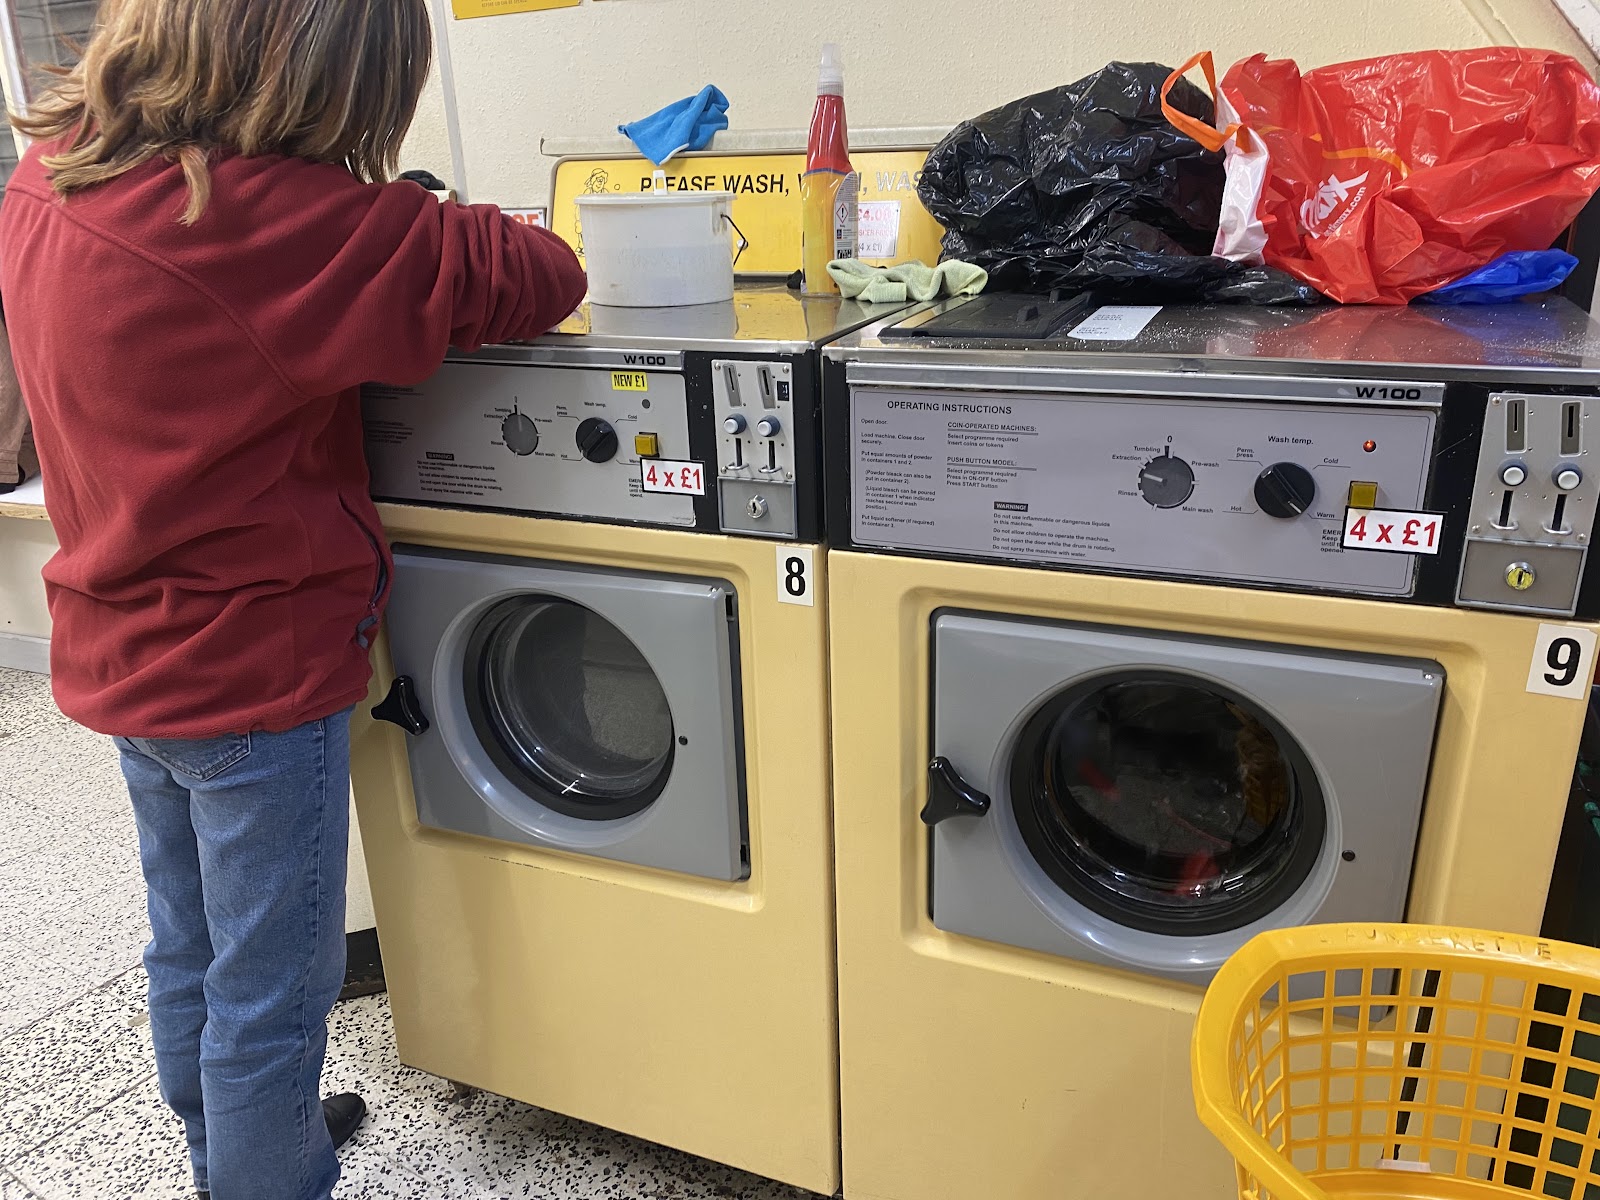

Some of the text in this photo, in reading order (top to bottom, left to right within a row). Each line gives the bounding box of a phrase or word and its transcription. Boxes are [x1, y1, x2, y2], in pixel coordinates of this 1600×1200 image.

[724, 173, 789, 197] WASH,
[876, 171, 923, 192] WAS
[623, 354, 666, 366] W100
[613, 374, 646, 388] NEW £1
[1355, 386, 1421, 401] W100
[887, 400, 1012, 415] OPERATING INSTRUCTIONS
[947, 421, 1037, 432] COIN-OPERATED MACHINES:
[965, 434, 995, 442] programme
[1167, 435, 1173, 443] 0
[1267, 435, 1314, 447] Wash temp.
[870, 451, 884, 459] equal
[1133, 445, 1161, 453] Tumbling
[966, 457, 991, 465] BUTTON
[646, 465, 702, 490] 4 x £1
[996, 502, 1028, 511] WARNING!
[1230, 505, 1242, 513] Hot
[1316, 511, 1335, 519] Warm
[1022, 515, 1055, 523] inflammable
[1062, 518, 1092, 526] dangerous
[1091, 520, 1111, 528] liquids
[1350, 514, 1437, 547] 4 x £1
[1321, 535, 1339, 543] Keep
[784, 556, 806, 597] 8
[1543, 636, 1582, 687] 9
